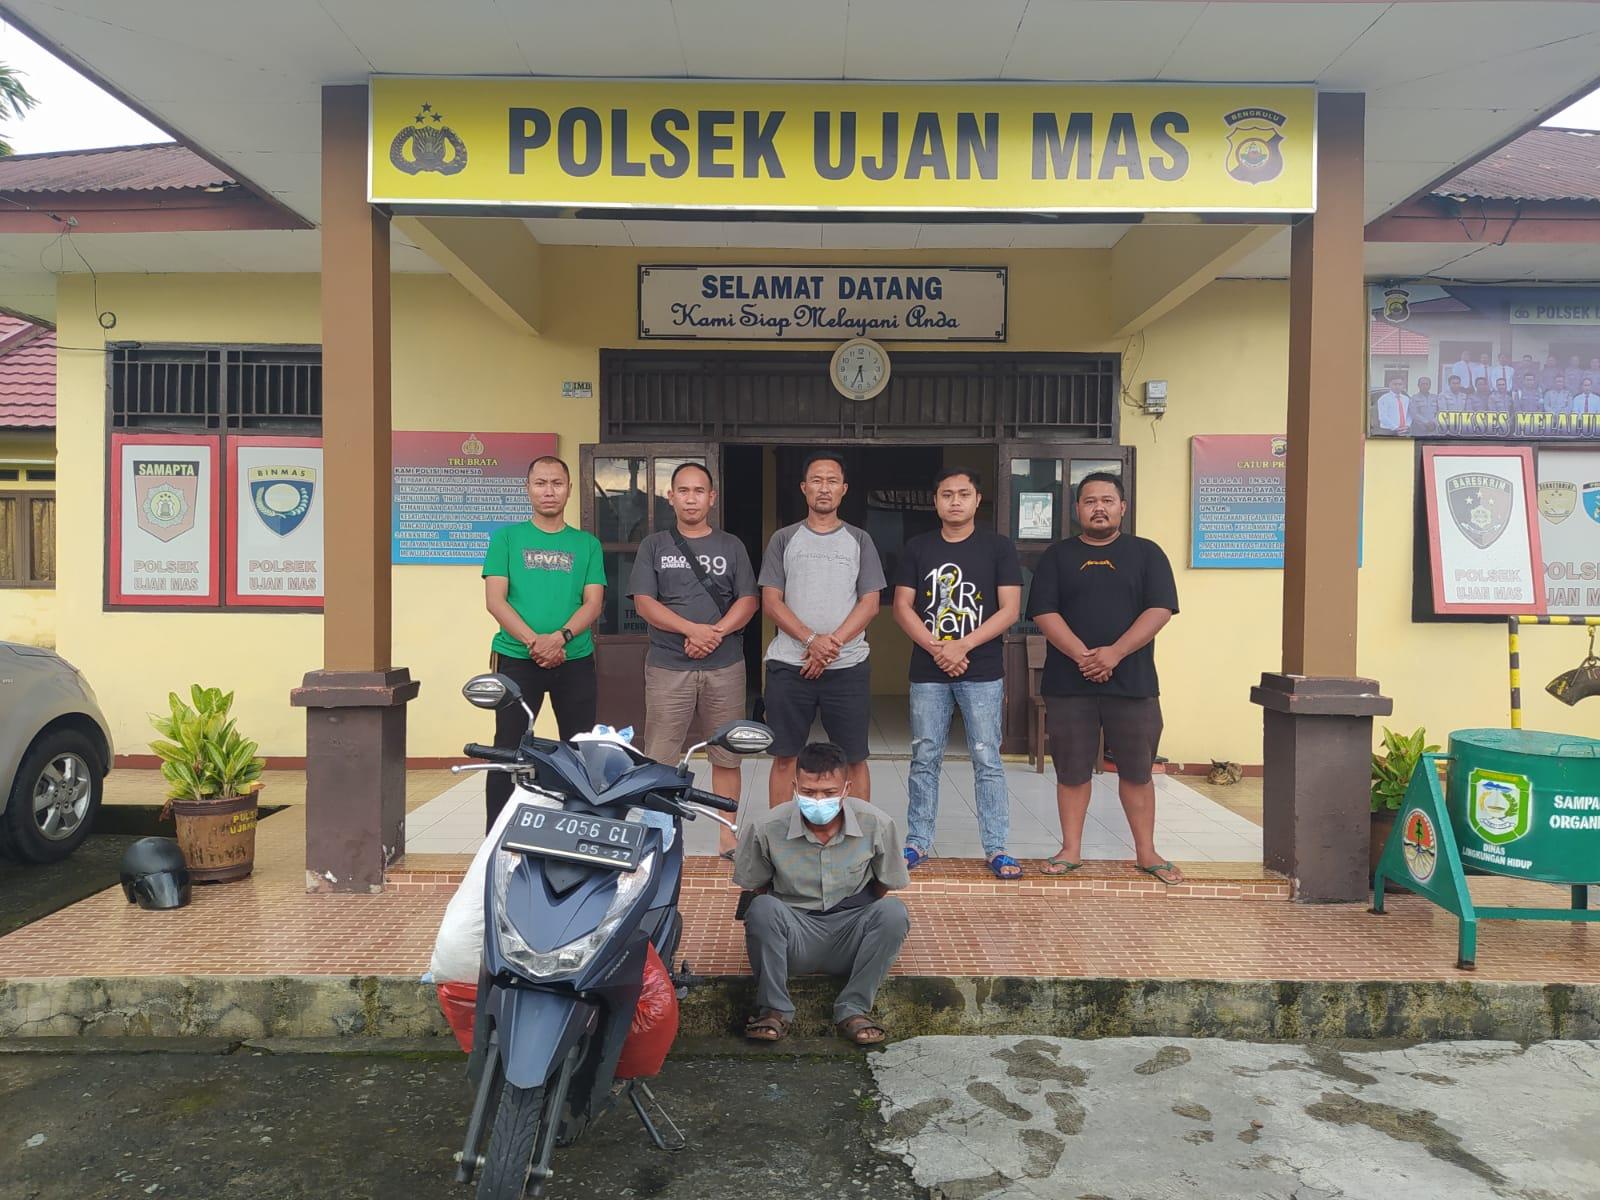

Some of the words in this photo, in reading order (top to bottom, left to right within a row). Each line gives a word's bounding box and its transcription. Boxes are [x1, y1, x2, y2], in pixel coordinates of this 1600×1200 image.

[1231, 110, 1280, 121] BENGKULU
[508, 107, 786, 179] POLSEK
[813, 111, 999, 181] UJAN
[1031, 112, 1190, 182] MAS
[701, 275, 824, 299] SELAMAT
[838, 277, 943, 300] DATANG
[1536, 305, 1591, 320] POLSEK
[671, 303, 736, 328] Kami
[739, 303, 792, 336] Siap
[794, 304, 900, 337] Melayani
[905, 304, 960, 329] Anda
[1437, 411, 1510, 436] SUKSES
[448, 458, 466, 466] TRI
[467, 458, 499, 466] BRATA
[1237, 460, 1269, 469] CATUR
[138, 463, 195, 476] SAMAPTA
[257, 468, 306, 477] BINMAS
[1453, 476, 1506, 489] BARESKRIM
[661, 555, 687, 563] POLO
[133, 560, 199, 573] POLSEK
[249, 560, 318, 573] POLSEK
[1543, 561, 1600, 581] OLS
[1455, 569, 1521, 582] POLSEK
[133, 577, 166, 590] UJAN
[171, 577, 199, 591] MAS
[249, 577, 283, 590] UJAN
[288, 577, 317, 590] MAS
[1457, 586, 1490, 600] UJAN
[1493, 586, 1523, 600] MAS
[1546, 587, 1580, 606] JAN
[520, 811, 546, 829] BD
[555, 817, 601, 838] 4056
[608, 826, 630, 844] GL
[1483, 843, 1505, 856] DINAS
[1462, 846, 1505, 866] LINGKUNGAN
[1507, 857, 1533, 870] HIDUP
